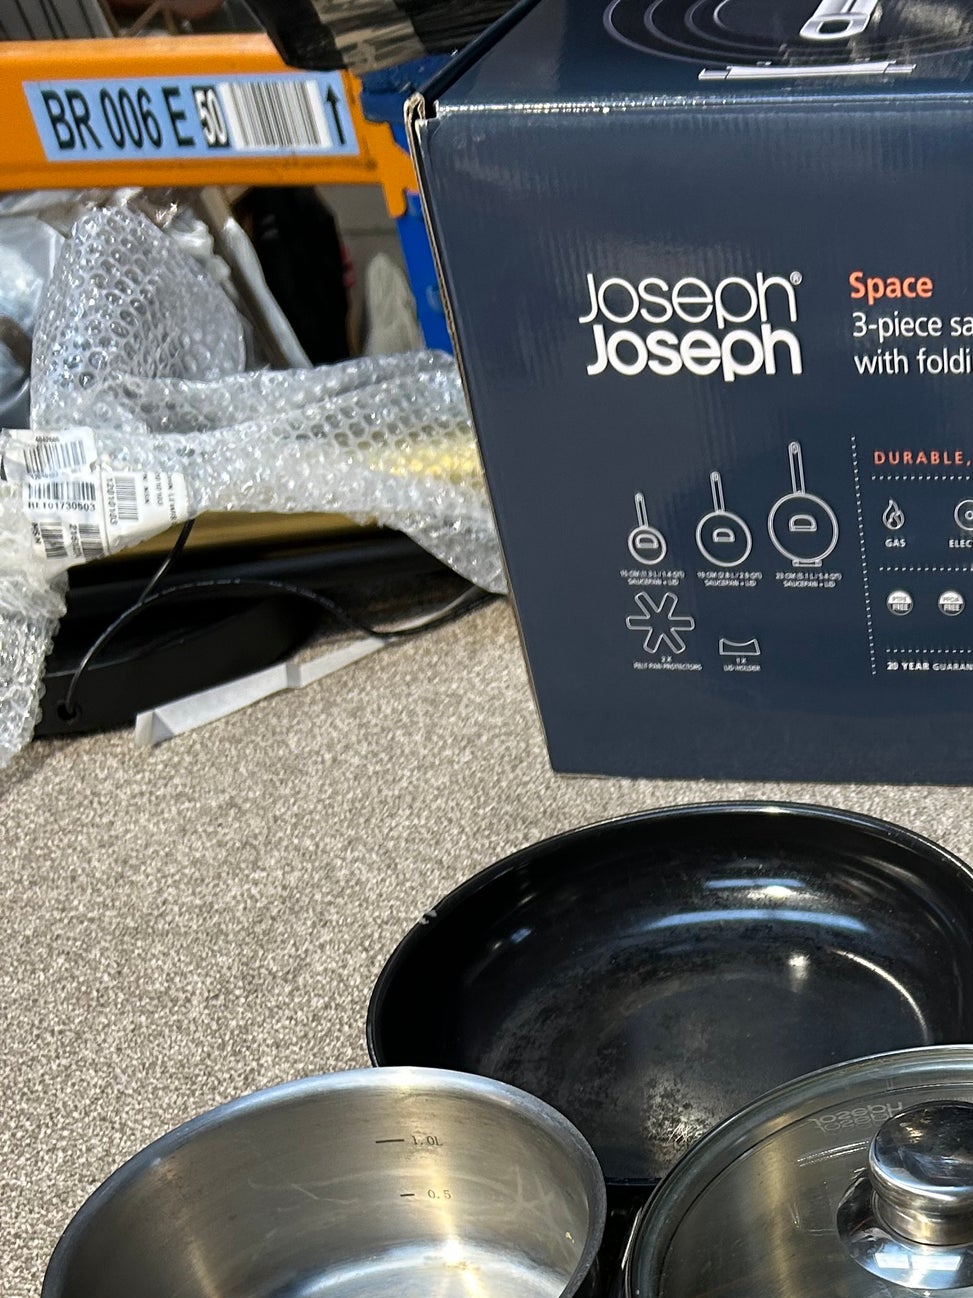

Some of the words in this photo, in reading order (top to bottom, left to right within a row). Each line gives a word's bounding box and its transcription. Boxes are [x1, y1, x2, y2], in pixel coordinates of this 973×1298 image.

[41, 86, 102, 150] BR
[100, 87, 163, 149] 006
[162, 86, 195, 148] E
[849, 270, 933, 305] Space
[852, 311, 943, 343] 3-piece
[586, 323, 802, 382] Joseph
[854, 349, 909, 375] with
[873, 450, 971, 467] DURABLE,
[884, 539, 906, 549] GAS
[901, 661, 930, 671] YEAR
[427, 1189, 451, 1200] 0.5
